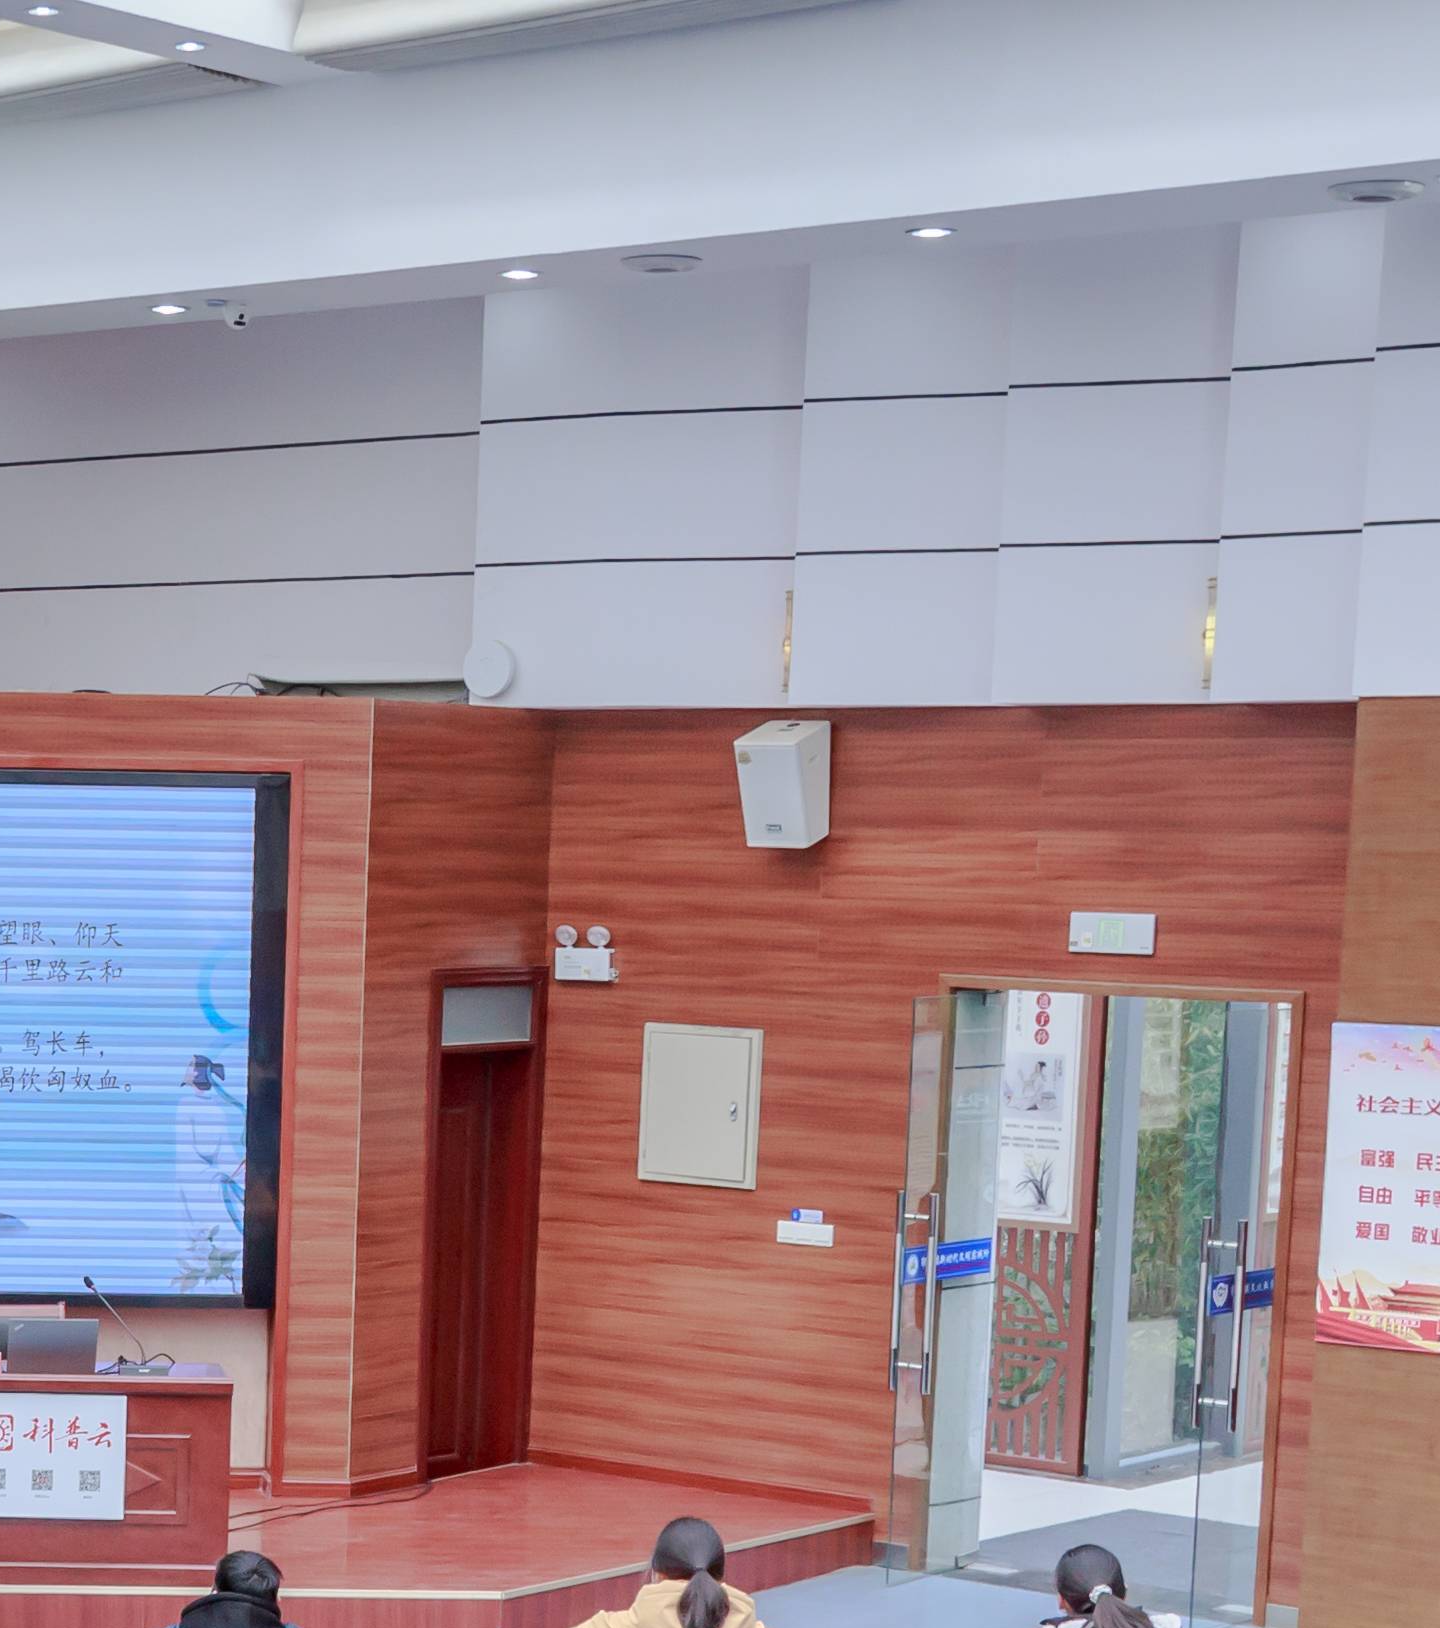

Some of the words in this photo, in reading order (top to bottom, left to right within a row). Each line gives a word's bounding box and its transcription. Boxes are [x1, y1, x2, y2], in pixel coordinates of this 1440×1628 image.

[1361, 1149, 1395, 1169] 富强
[1358, 1185, 1393, 1206] 自由
[1356, 1221, 1390, 1242] 爱国
[22, 1416, 112, 1454] 科普云
